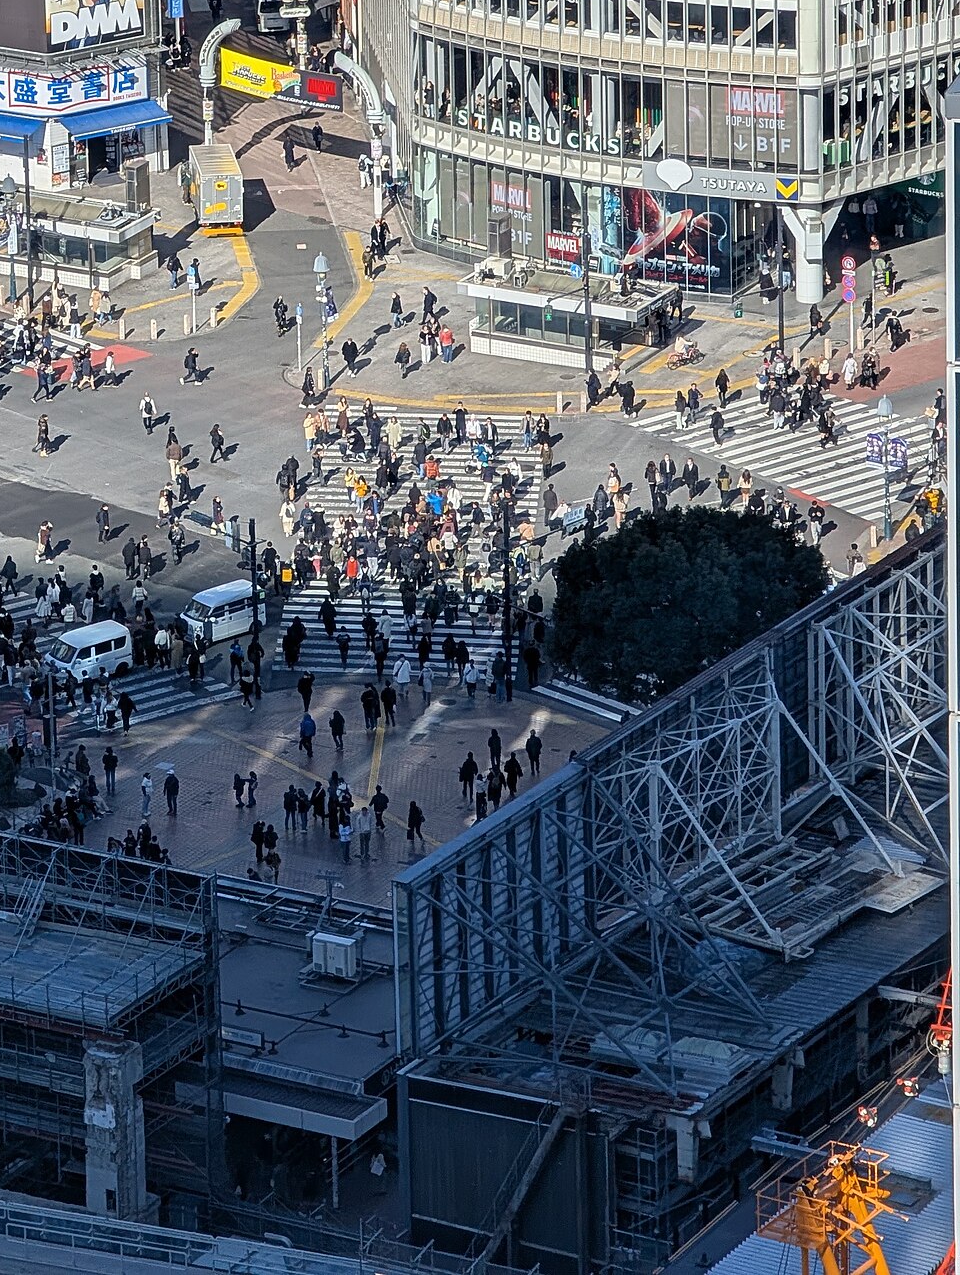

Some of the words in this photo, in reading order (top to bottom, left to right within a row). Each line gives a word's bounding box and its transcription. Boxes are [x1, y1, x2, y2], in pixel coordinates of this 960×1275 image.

[729, 91, 783, 114] MARVEL
[725, 114, 757, 127] POP-UP
[758, 116, 786, 130] STORE
[457, 109, 620, 155] STARBUCKS
[700, 177, 767, 193] TSUTAYA
[908, 187, 945, 198] STARBUCKS
[547, 234, 579, 254] MARVEL
